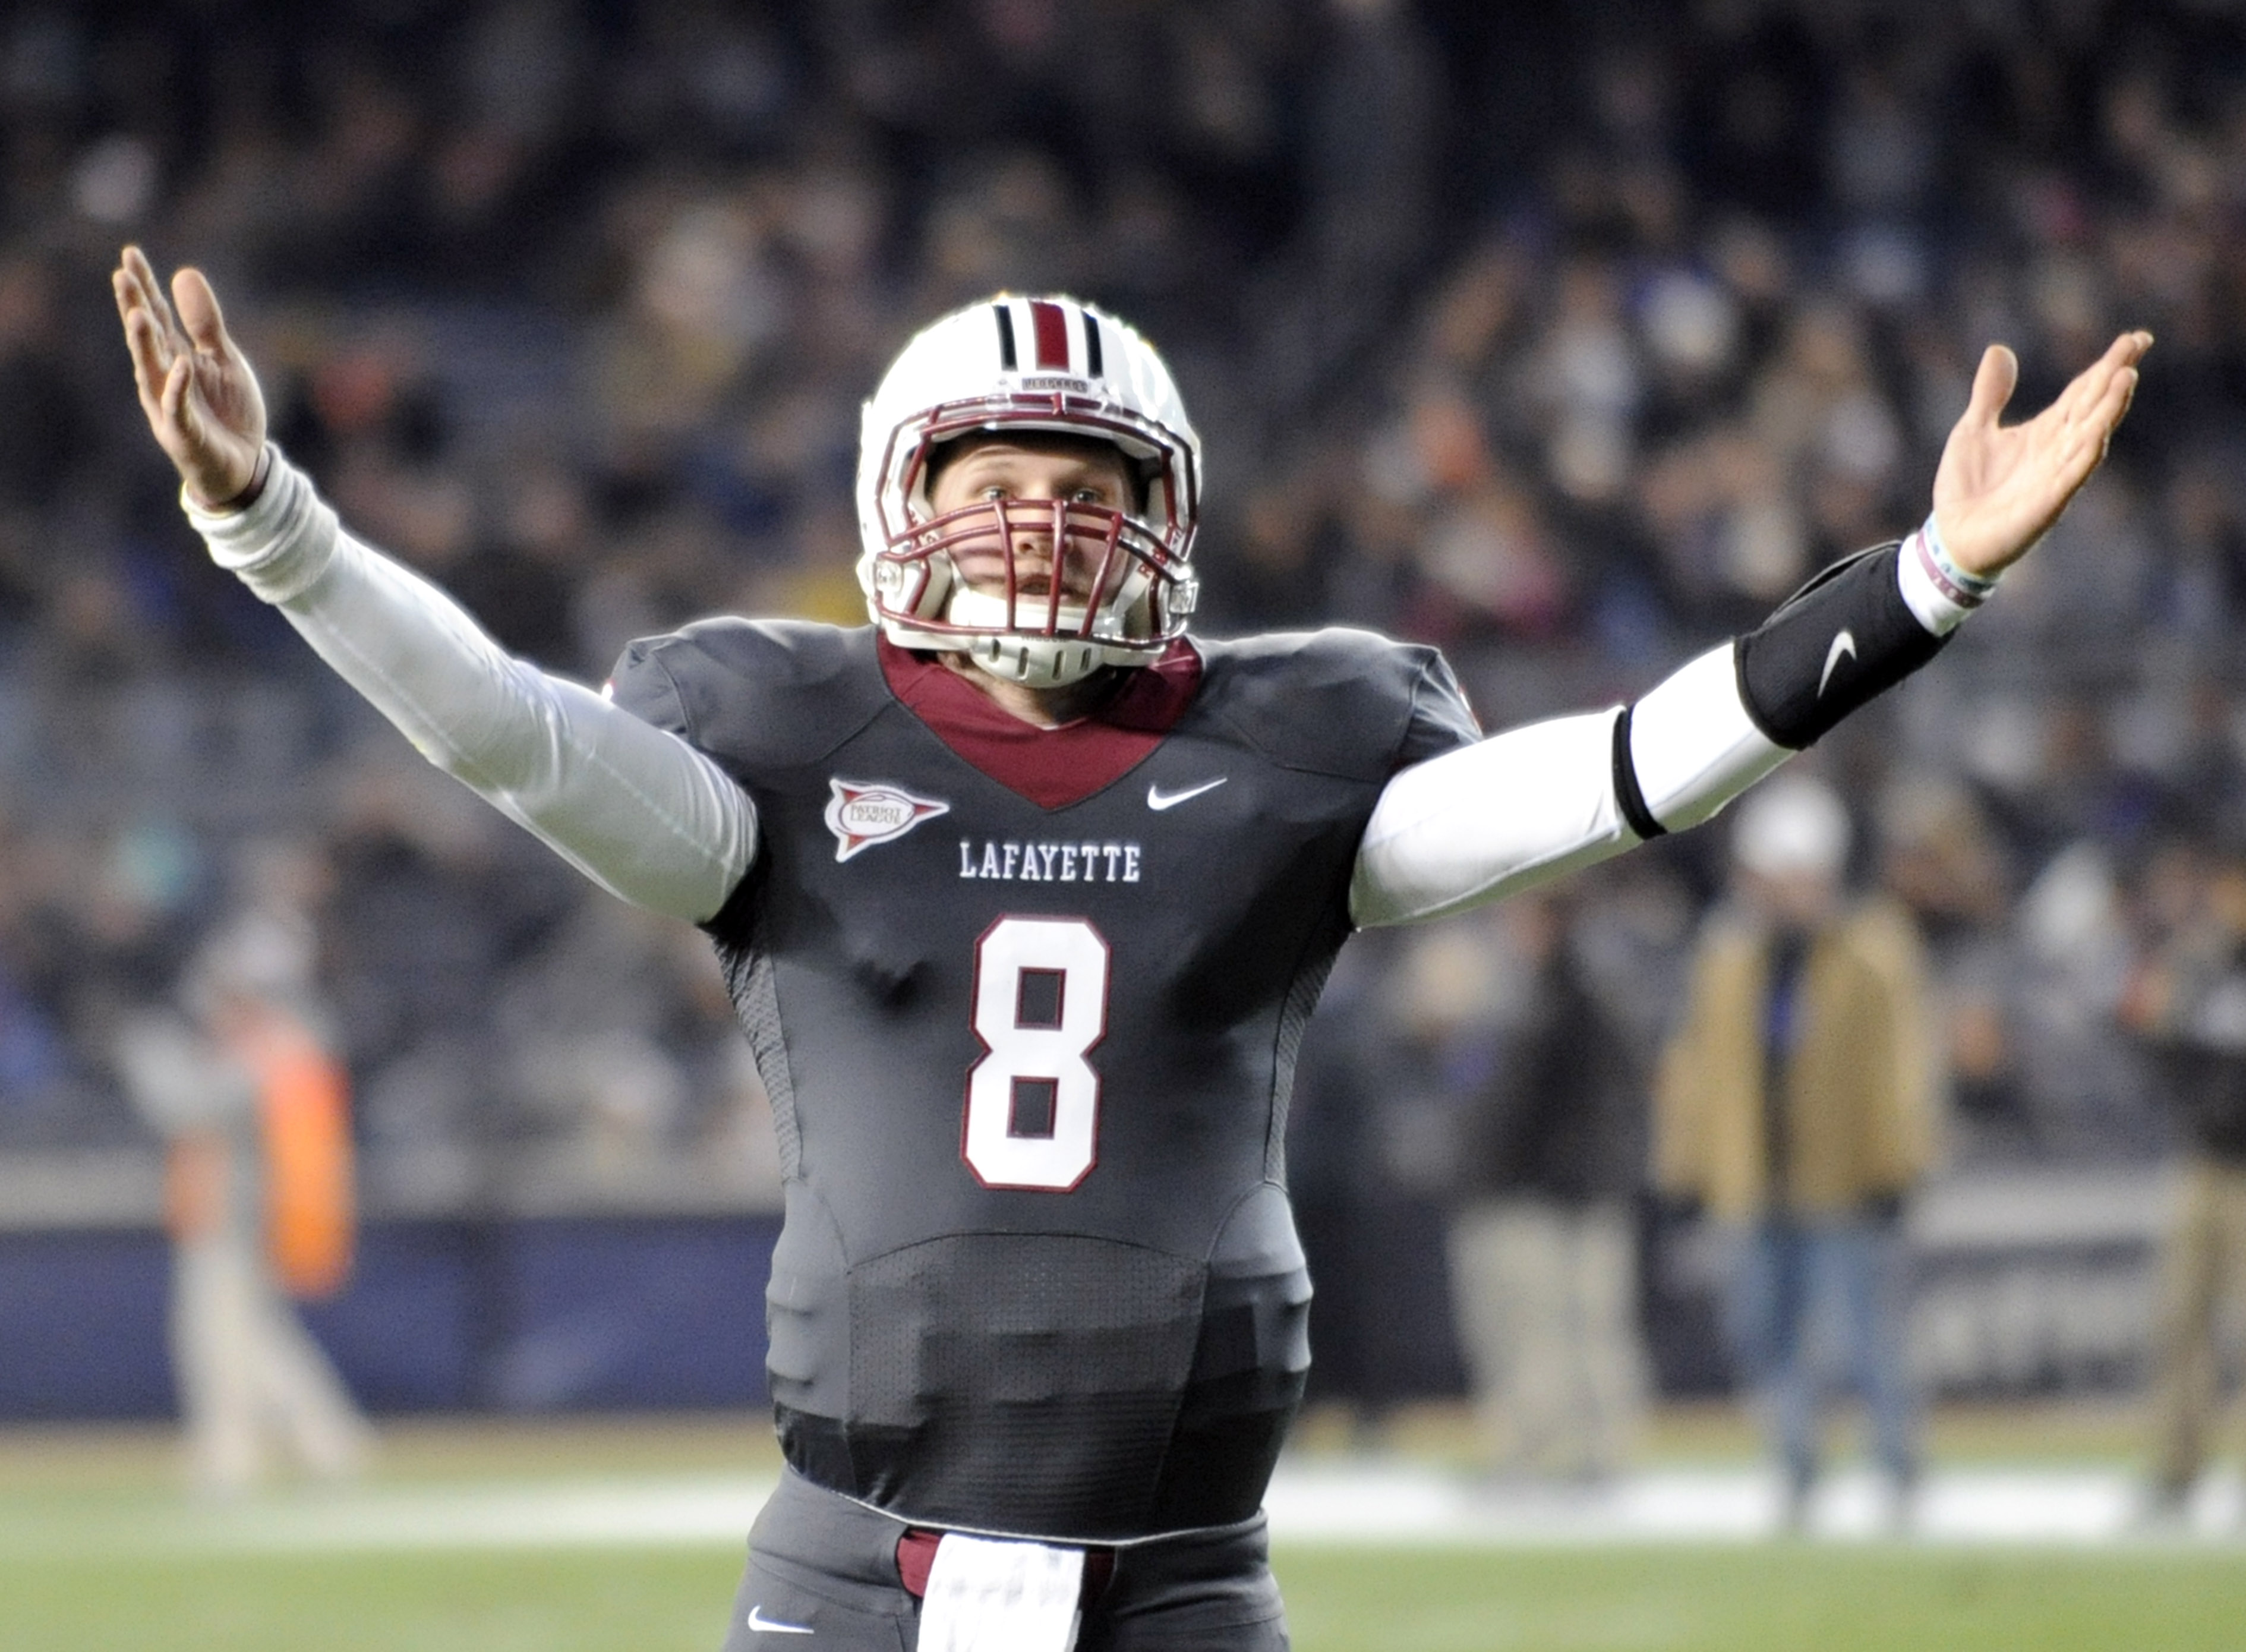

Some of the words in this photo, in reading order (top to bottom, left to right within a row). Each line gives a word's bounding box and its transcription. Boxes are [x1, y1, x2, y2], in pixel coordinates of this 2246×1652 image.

[850, 805, 901, 816] PATRIOT
[850, 812, 901, 824] LEAGUE
[959, 841, 1140, 882] LAFAYETTE
[959, 913, 1112, 1192] 8
